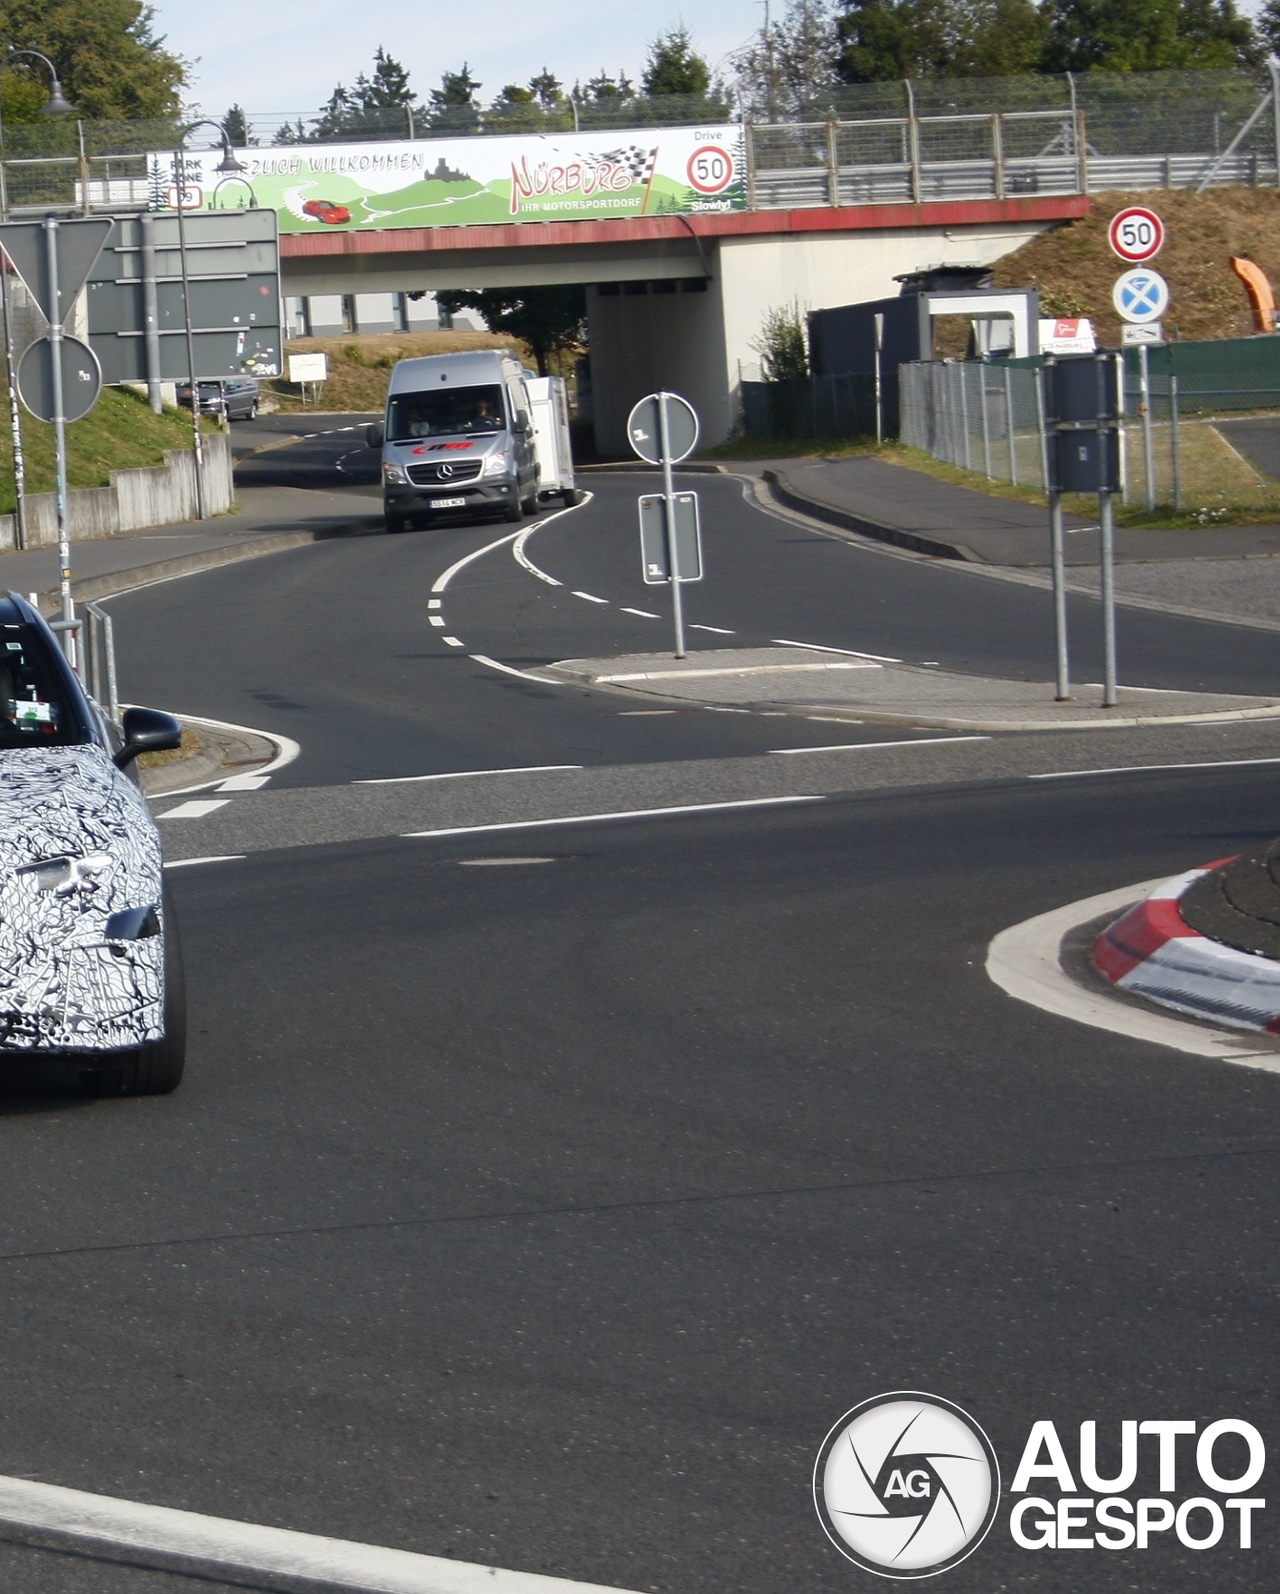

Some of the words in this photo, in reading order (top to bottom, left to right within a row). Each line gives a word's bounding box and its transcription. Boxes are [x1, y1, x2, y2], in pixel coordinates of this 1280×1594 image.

[694, 130, 722, 141] Drive
[309, 152, 424, 174] WILLKOMMEN
[697, 158, 724, 180] 50
[521, 204, 540, 212] IHR
[543, 198, 641, 211] MOTORSPORTDORF
[691, 200, 732, 211] Slowly!
[1122, 223, 1152, 246] 50
